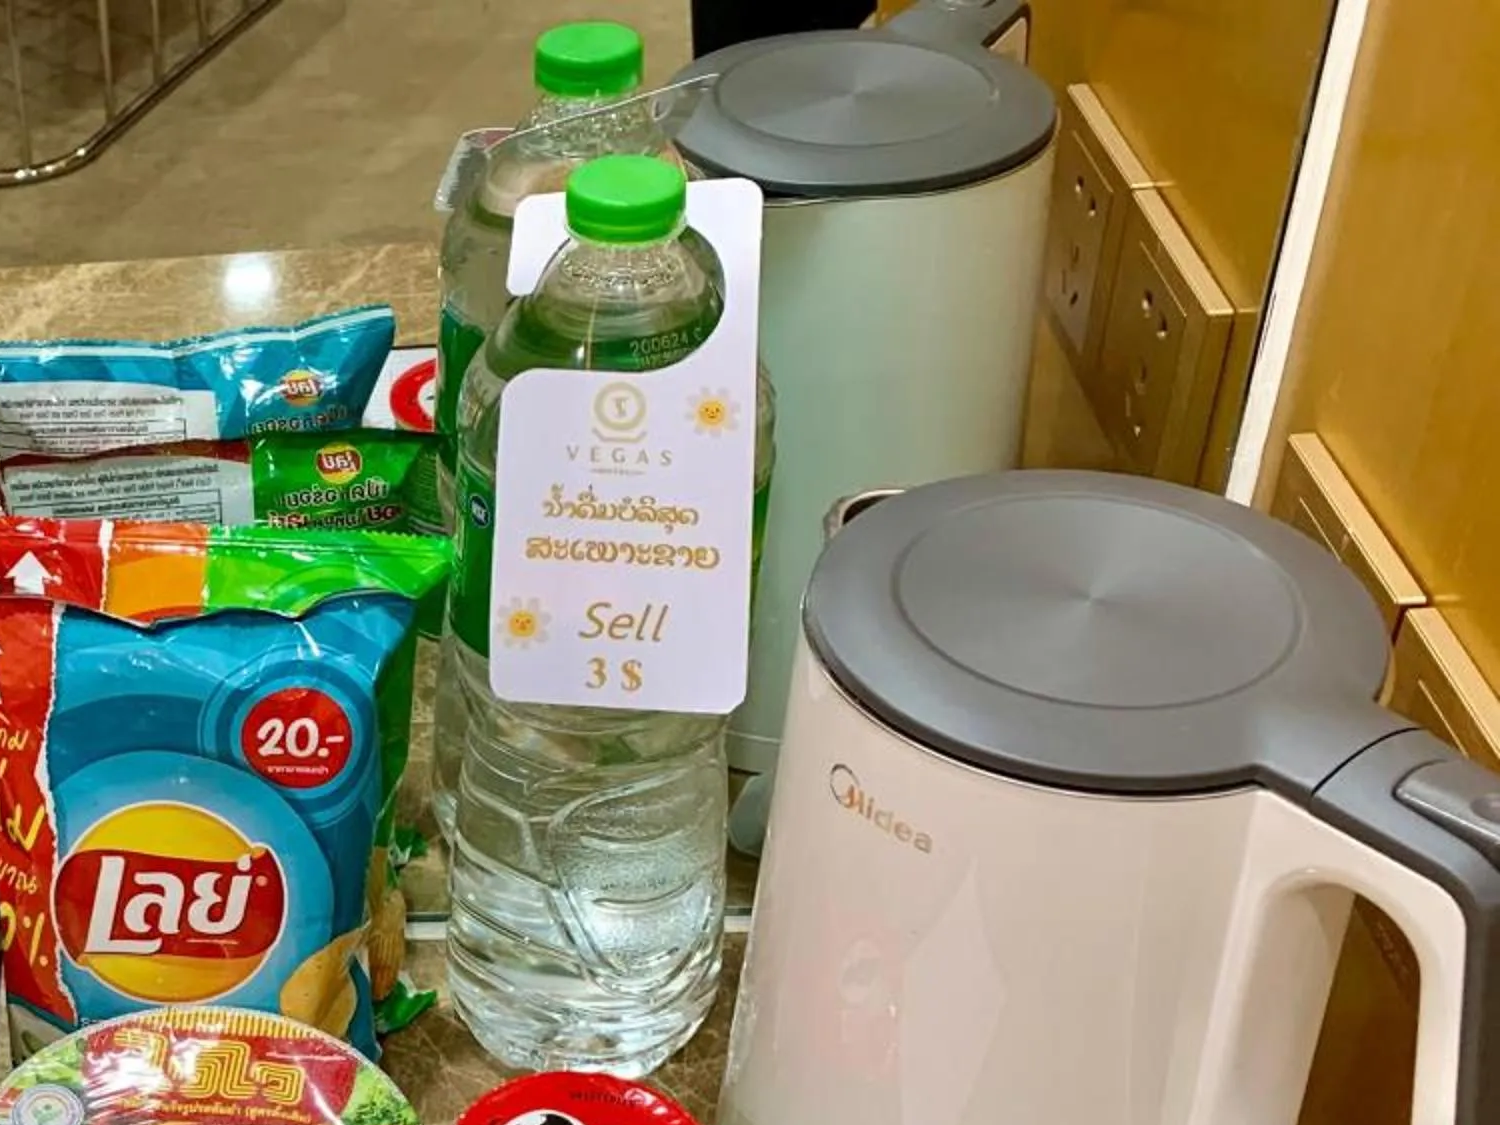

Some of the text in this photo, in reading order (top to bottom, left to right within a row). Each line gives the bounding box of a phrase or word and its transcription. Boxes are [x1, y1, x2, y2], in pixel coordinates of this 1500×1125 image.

[566, 444, 674, 467] VEGAS
[578, 601, 669, 643] Sell
[585, 657, 643, 692] 3 $
